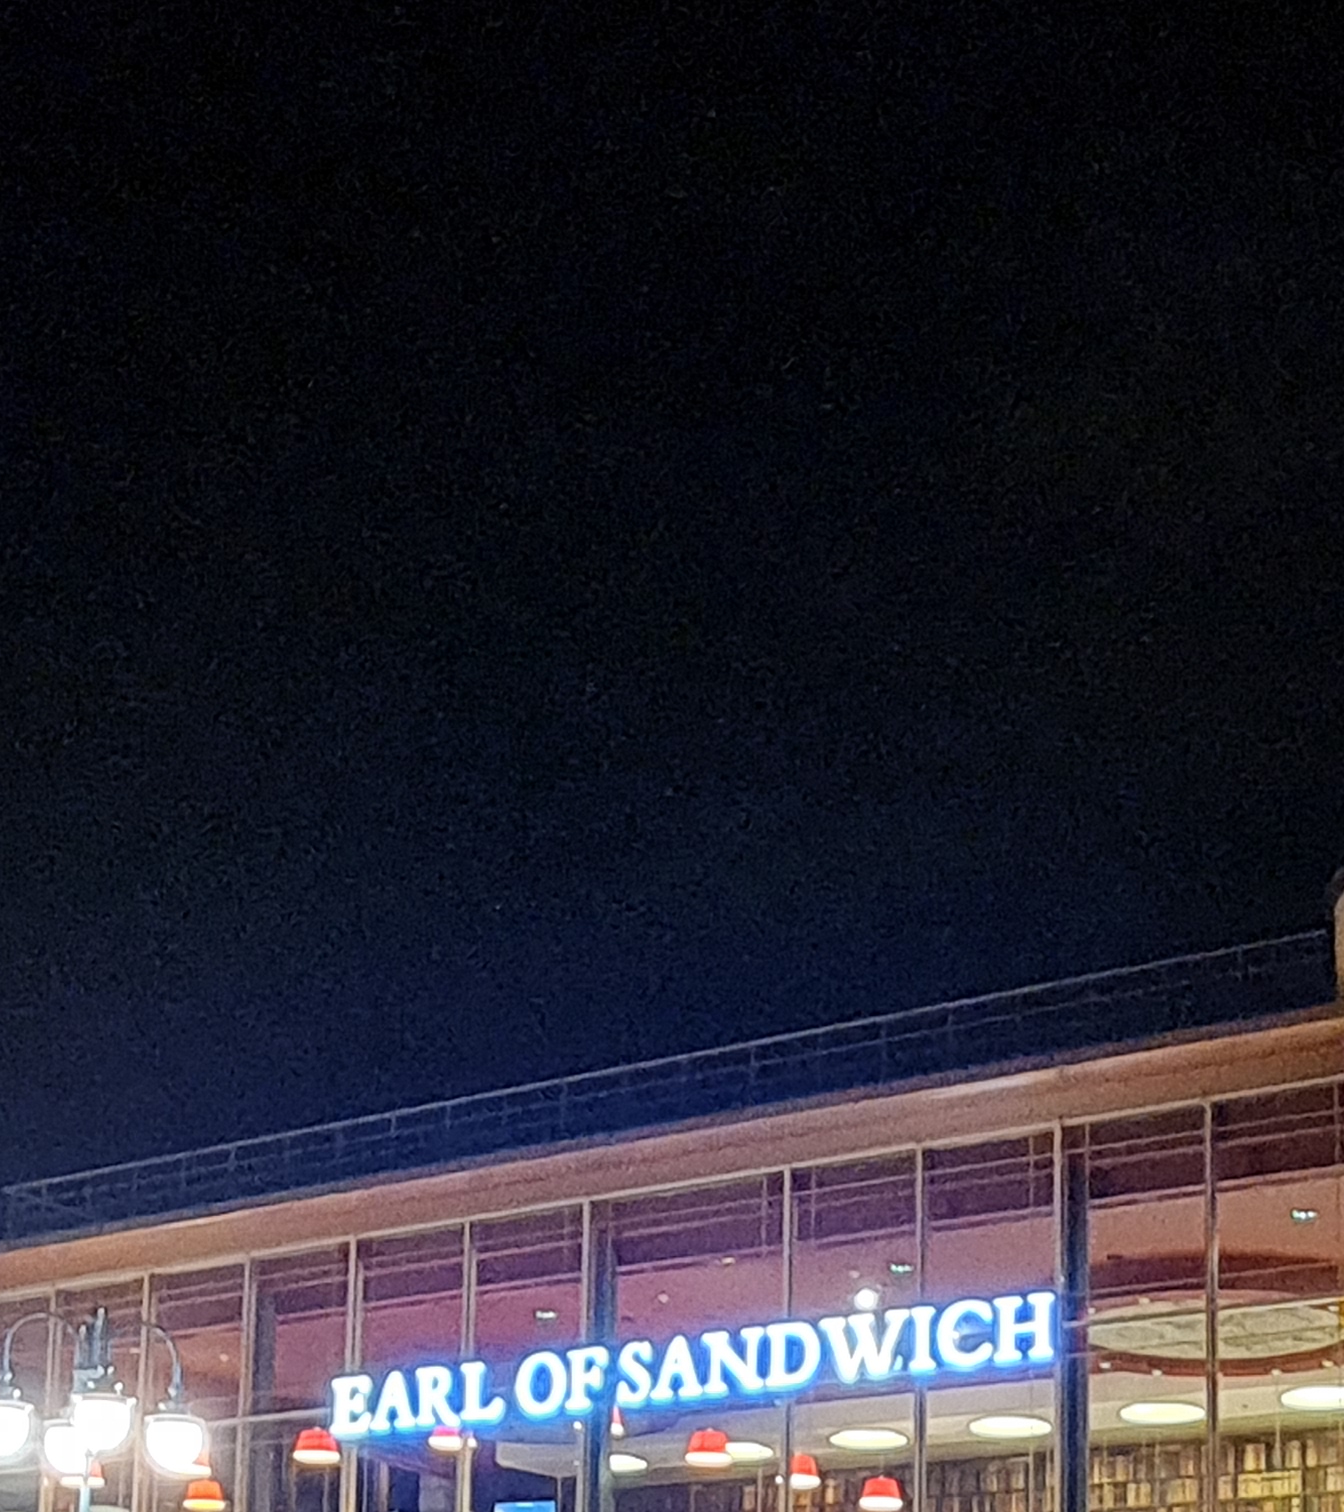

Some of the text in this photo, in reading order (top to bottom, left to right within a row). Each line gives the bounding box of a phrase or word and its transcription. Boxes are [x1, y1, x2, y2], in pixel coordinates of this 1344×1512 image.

[330, 1291, 1056, 1438] EARL OF SANDWICH
